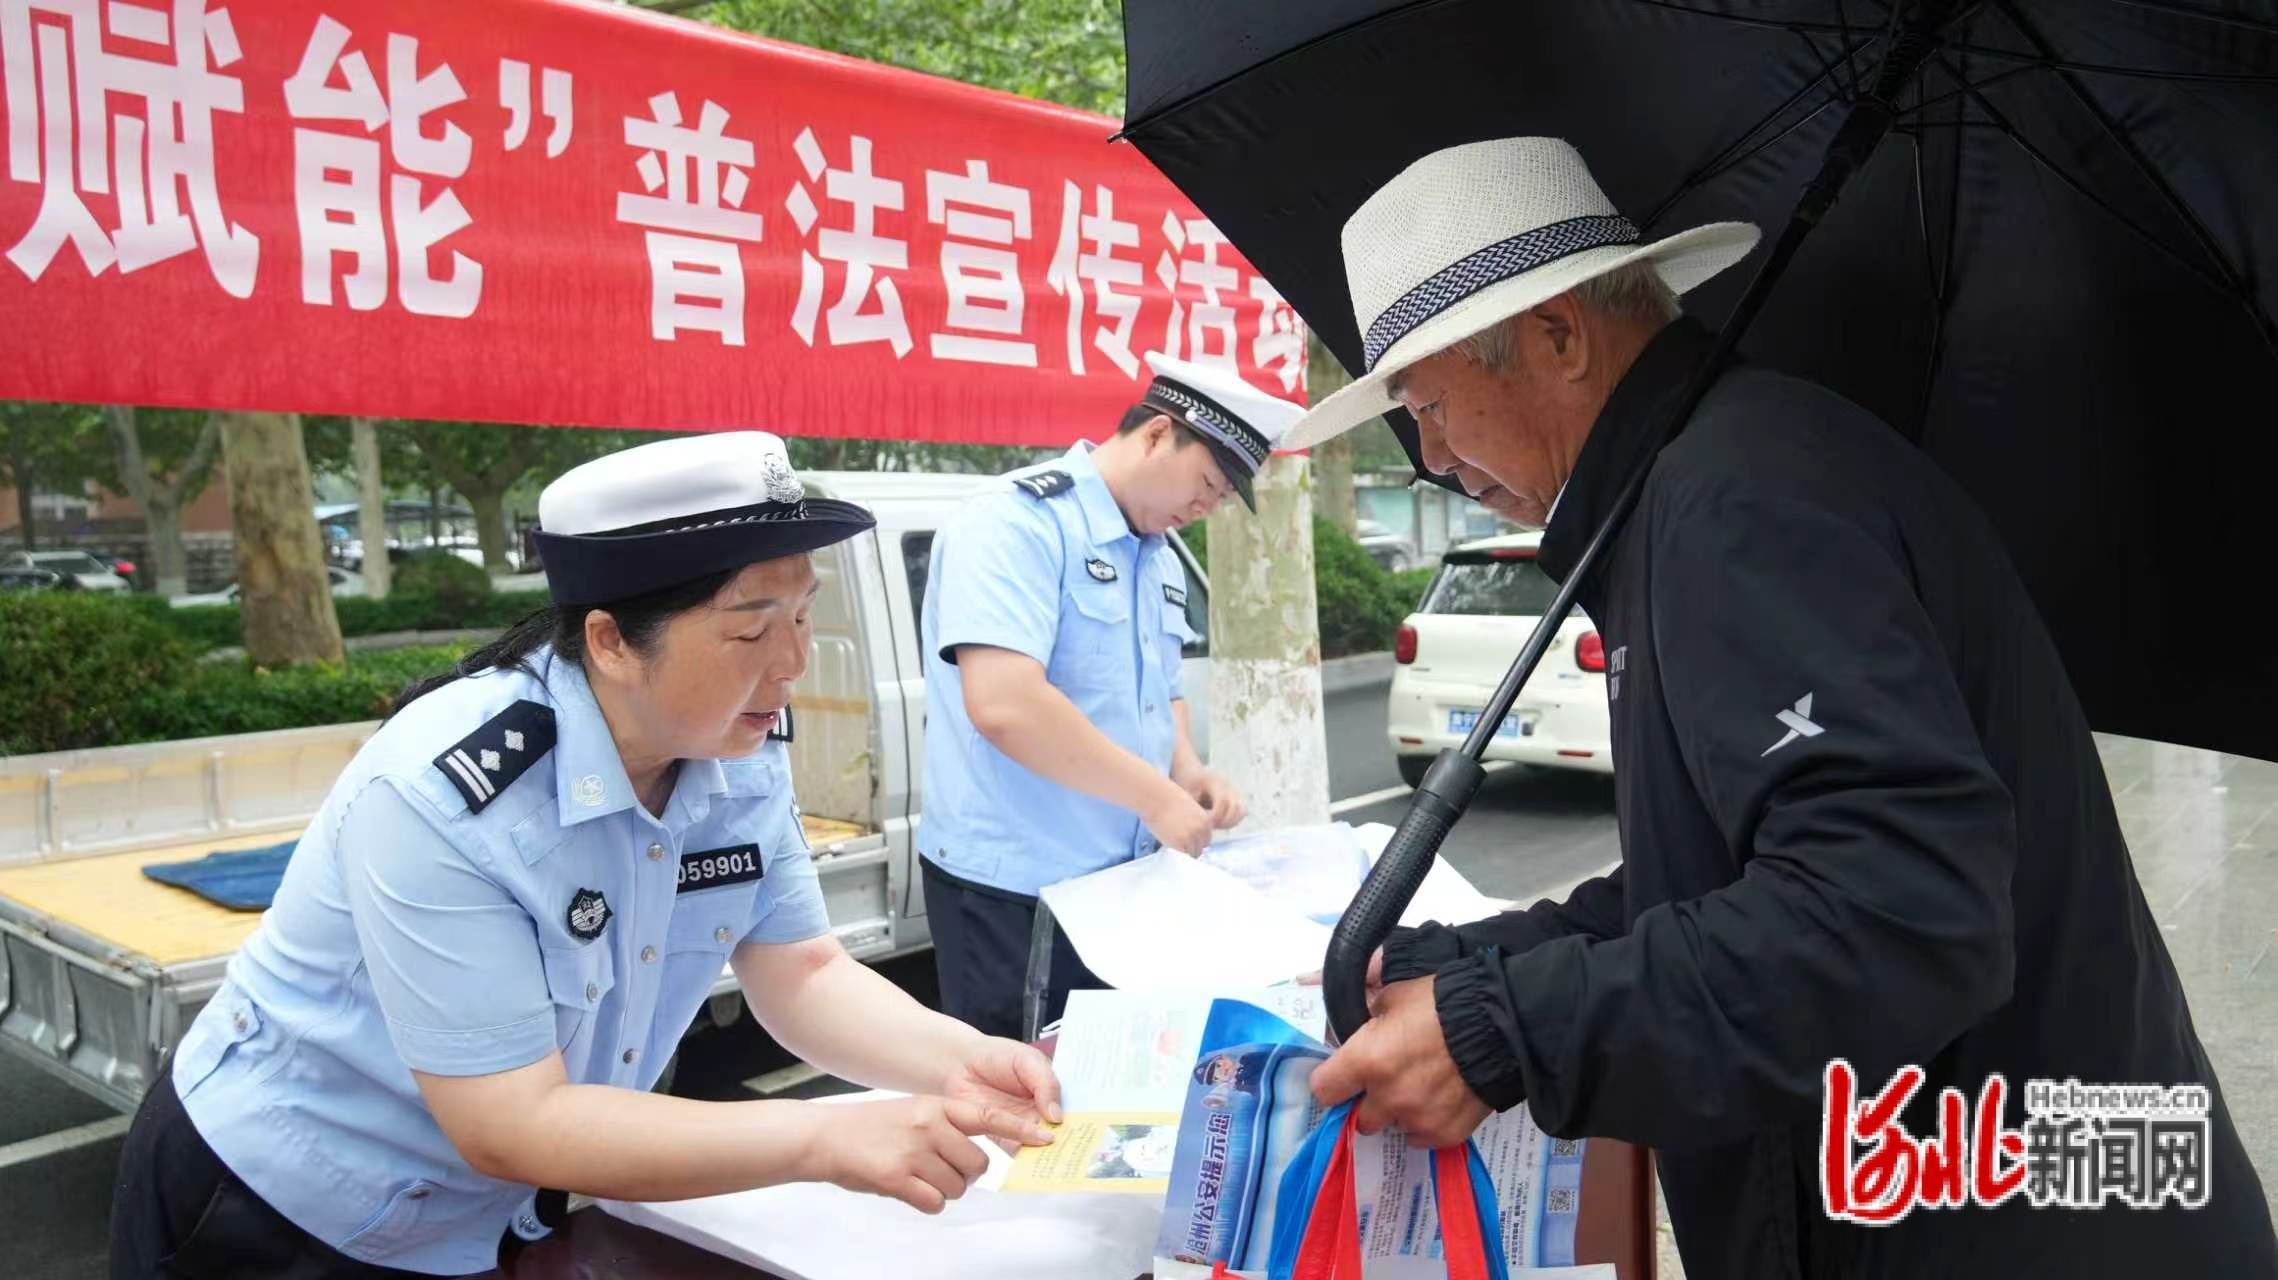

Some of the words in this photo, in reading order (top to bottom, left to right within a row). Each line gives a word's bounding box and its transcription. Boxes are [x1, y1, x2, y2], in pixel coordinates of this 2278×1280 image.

[1185, 1112, 1231, 1256] 沧州公安提示您
